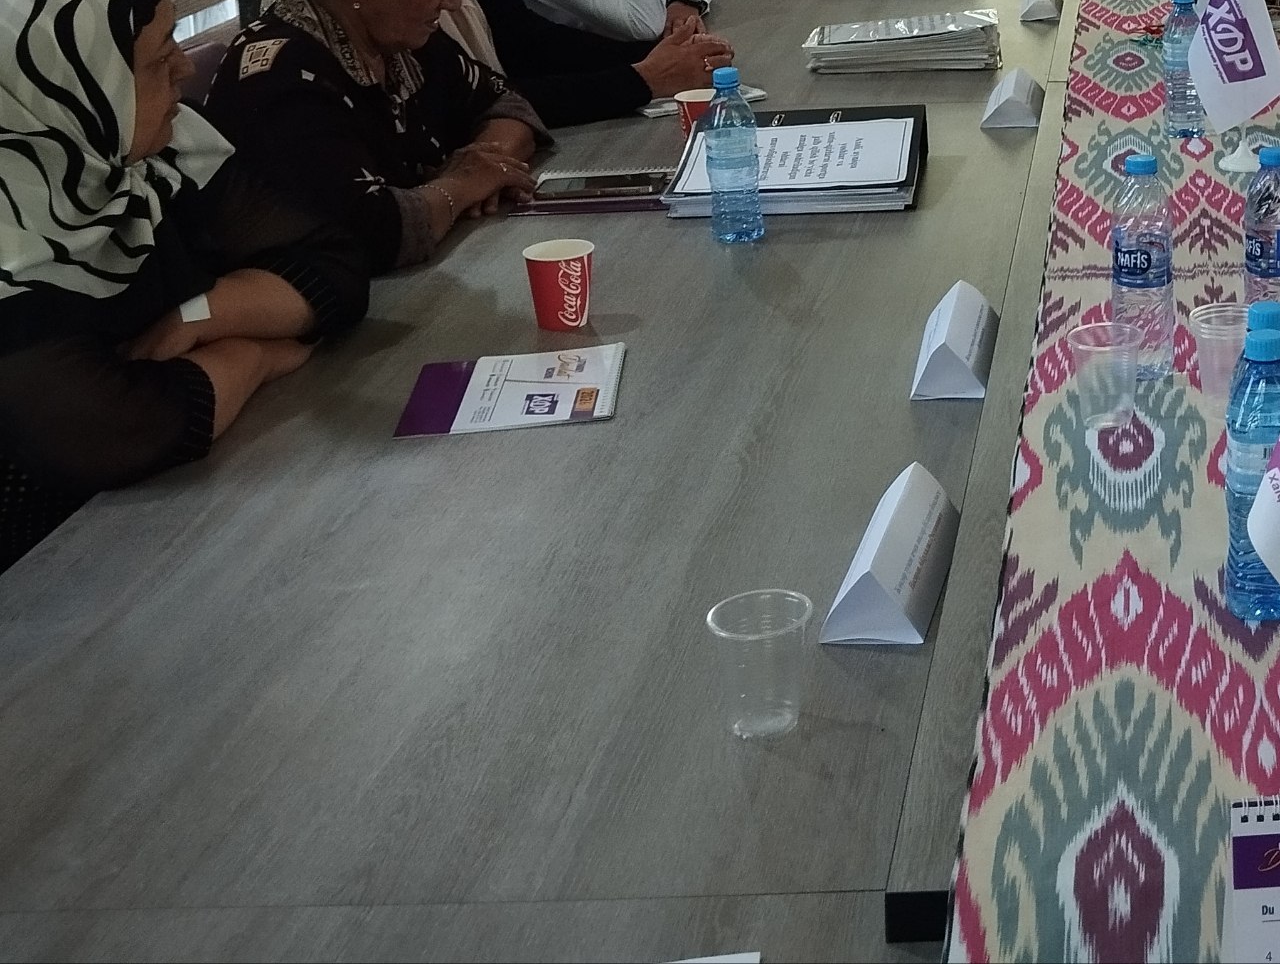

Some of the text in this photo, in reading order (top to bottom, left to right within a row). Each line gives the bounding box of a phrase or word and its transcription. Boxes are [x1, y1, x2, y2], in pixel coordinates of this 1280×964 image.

[1206, 1, 1254, 71] XDP
[1117, 251, 1148, 268] NAFIS
[1262, 905, 1275, 915] Du
[1265, 951, 1272, 962] 4
